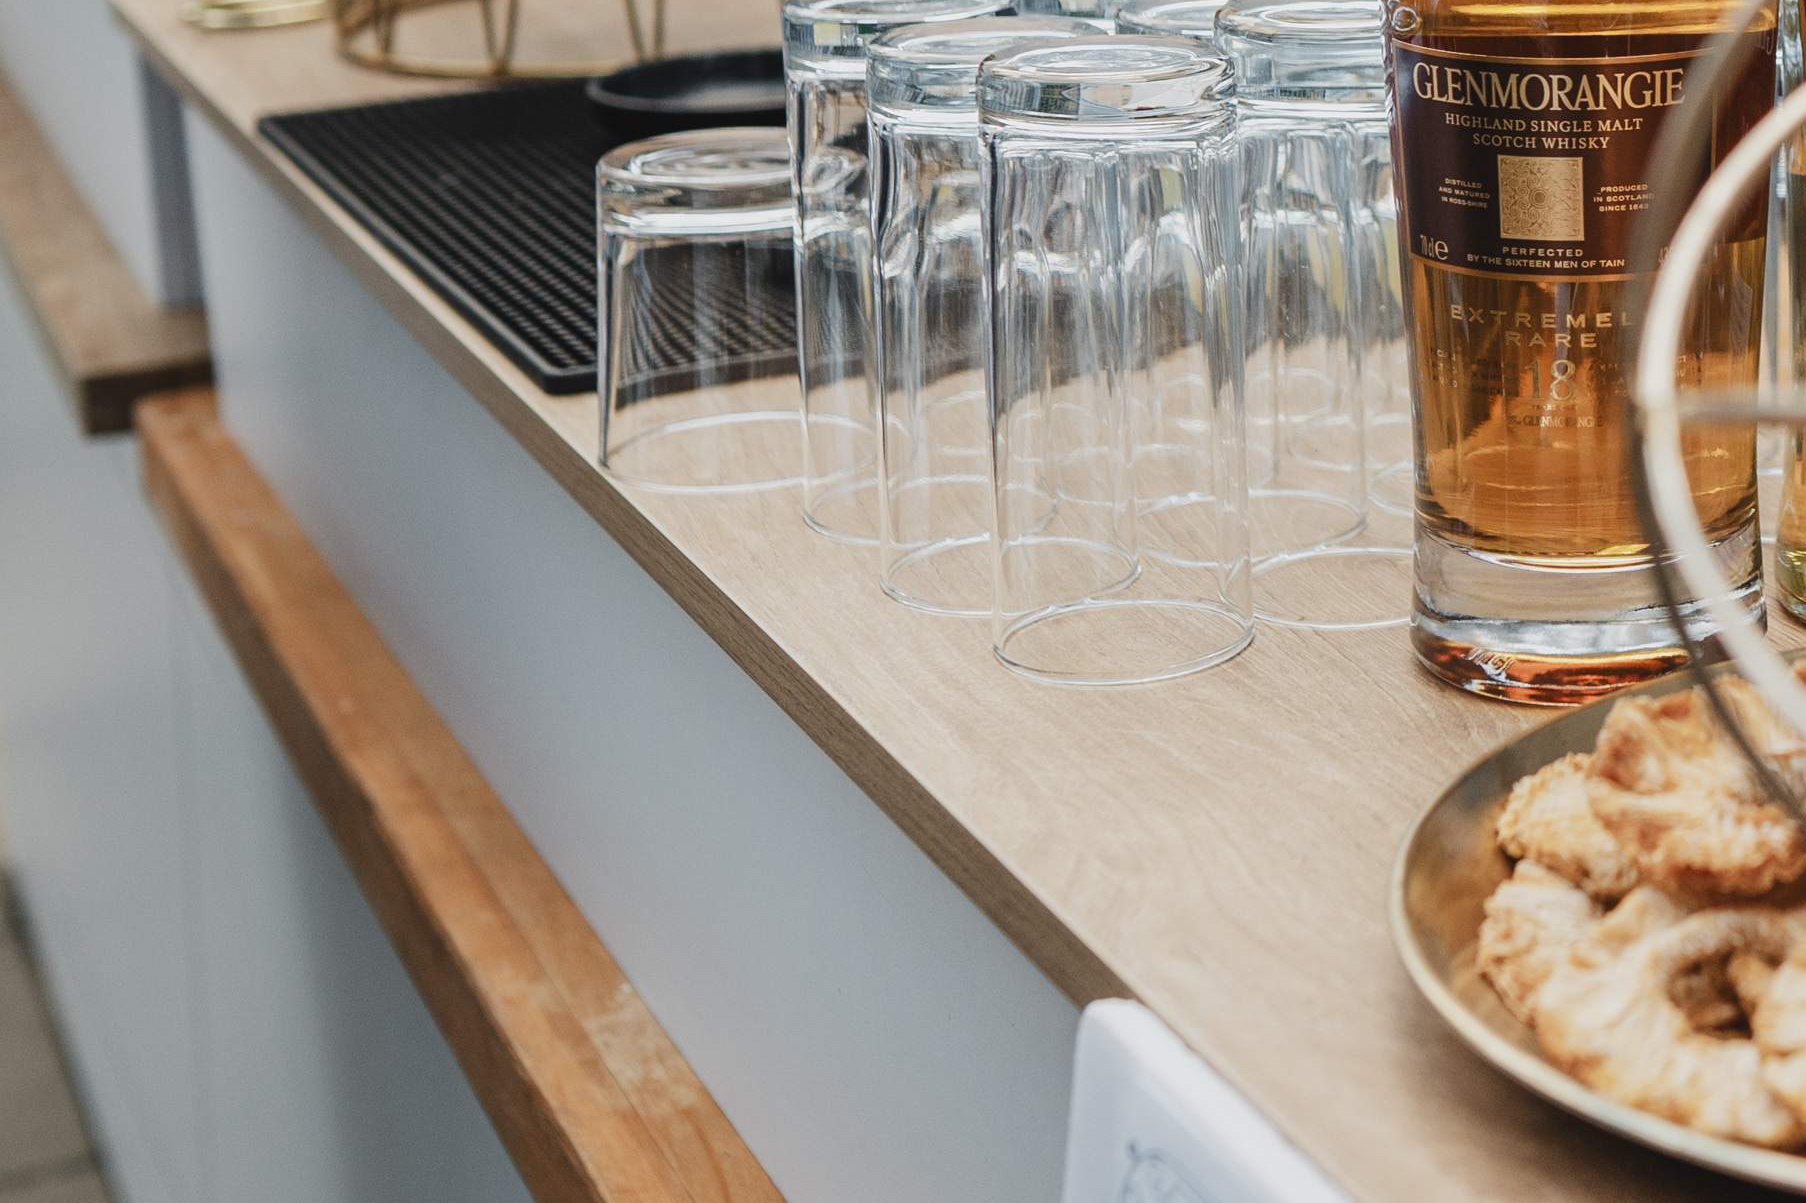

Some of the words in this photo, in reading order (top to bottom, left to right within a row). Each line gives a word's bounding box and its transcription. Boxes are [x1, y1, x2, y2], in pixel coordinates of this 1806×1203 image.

[1412, 61, 1686, 112] GLENMORANGIE
[1445, 112, 1527, 132] HIGHLAND
[1530, 119, 1593, 133] SINGLE
[1597, 117, 1644, 132] MALT
[1473, 132, 1537, 149] SCOTCH
[1541, 136, 1611, 149] WHISKY
[1444, 177, 1482, 189] DISTILLED
[1600, 183, 1648, 193] PRODUCED
[1438, 186, 1453, 194] AND
[1454, 189, 1491, 199] MATURED
[1606, 193, 1655, 202] SCOTLAND
[1598, 204, 1627, 212] SINCE
[1629, 203, 1649, 211] 1843
[1502, 246, 1584, 257] PERFECTED
[1466, 253, 1480, 262] BY
[1481, 255, 1502, 265] THE
[1505, 258, 1550, 268] SIXTEEN
[1554, 260, 1578, 269] MEN
[1581, 259, 1597, 268] OF
[1599, 259, 1625, 268] TAIN
[1450, 303, 1636, 329] EXTREMEL
[1504, 330, 1598, 348] RARE
[1524, 358, 1577, 401] 18
